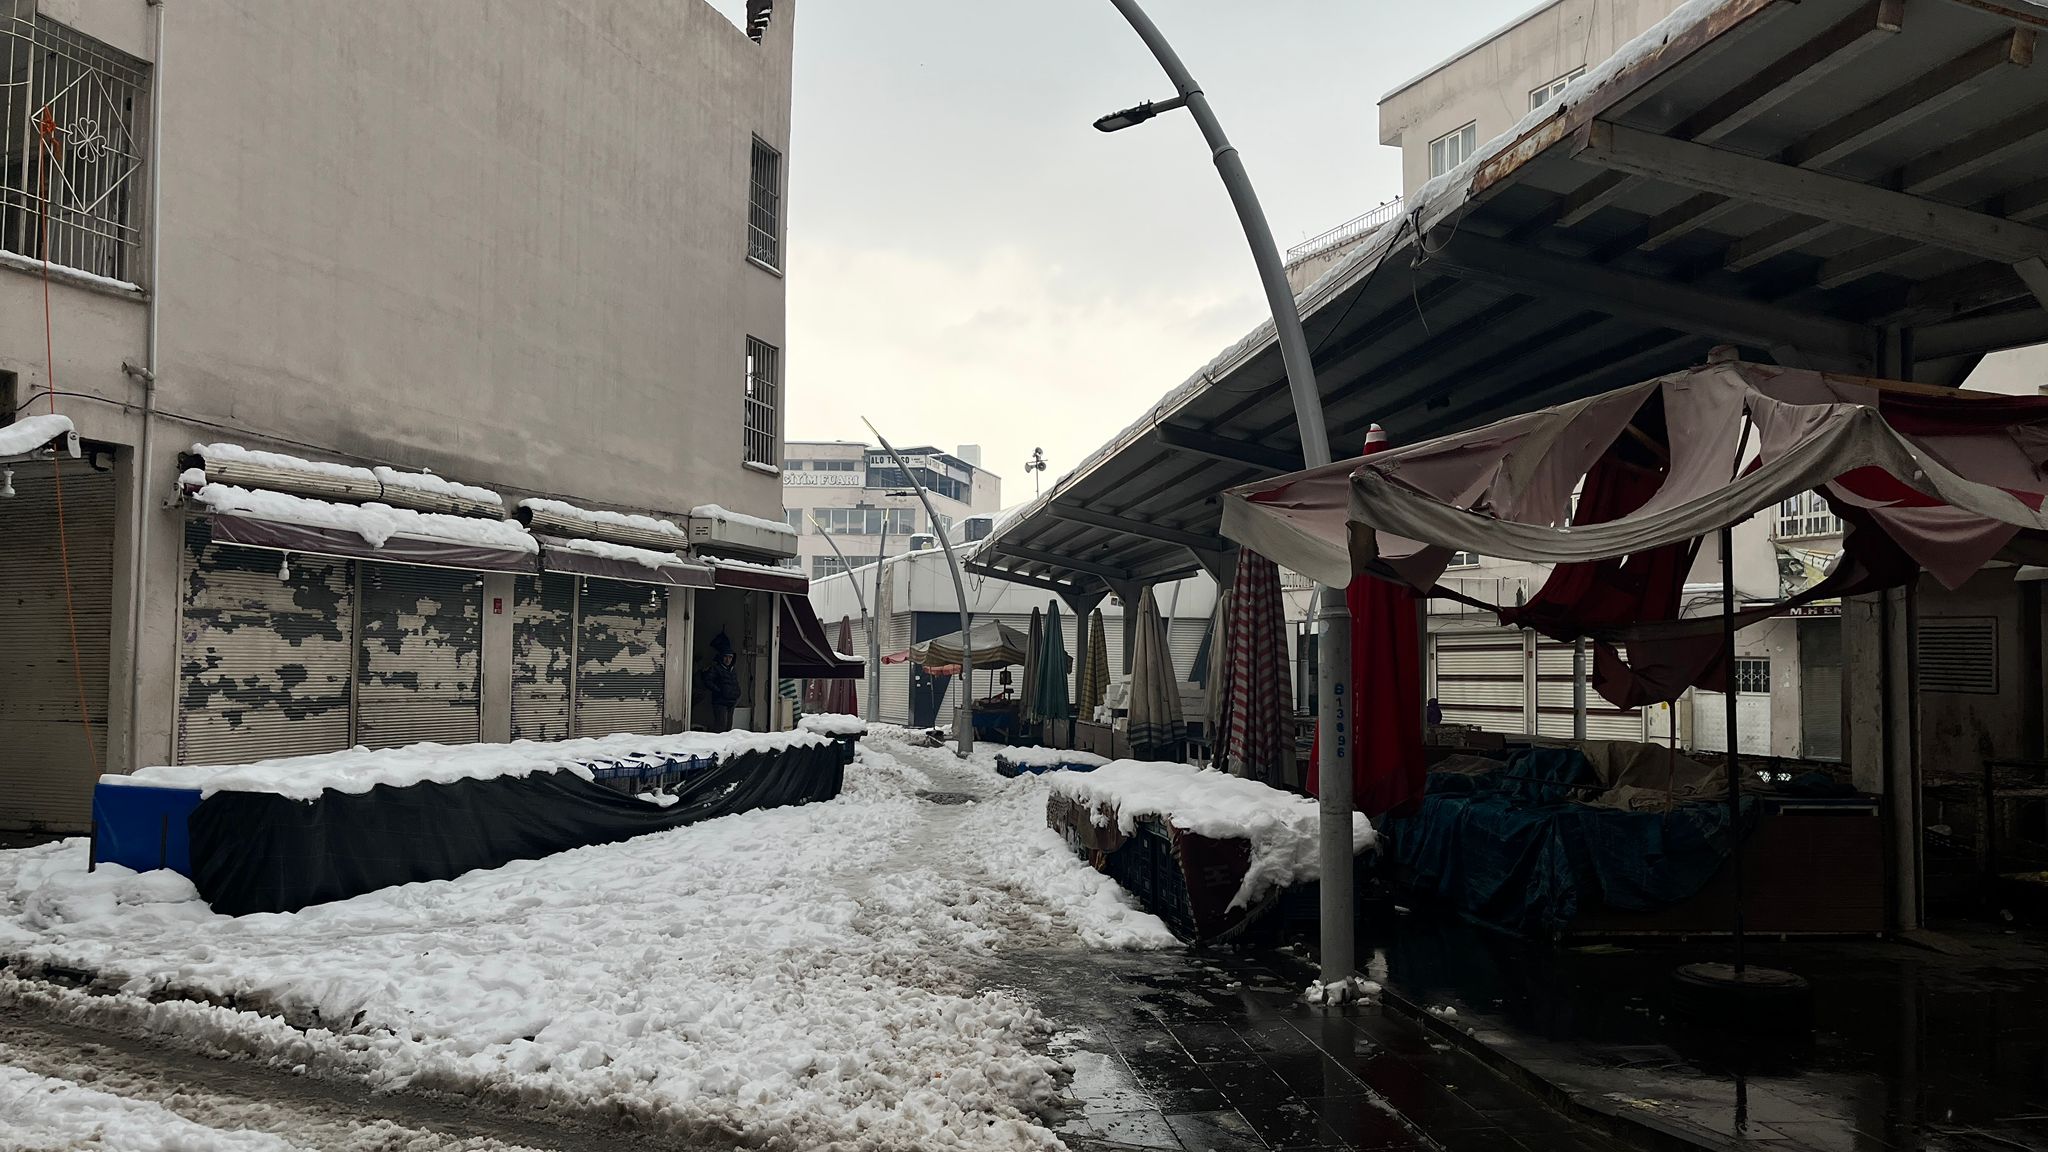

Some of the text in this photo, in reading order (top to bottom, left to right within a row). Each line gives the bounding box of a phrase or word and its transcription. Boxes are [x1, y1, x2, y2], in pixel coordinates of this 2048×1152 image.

[871, 456, 884, 464] ALO
[887, 456, 909, 464] TSO
[820, 475, 859, 485] FUARI
